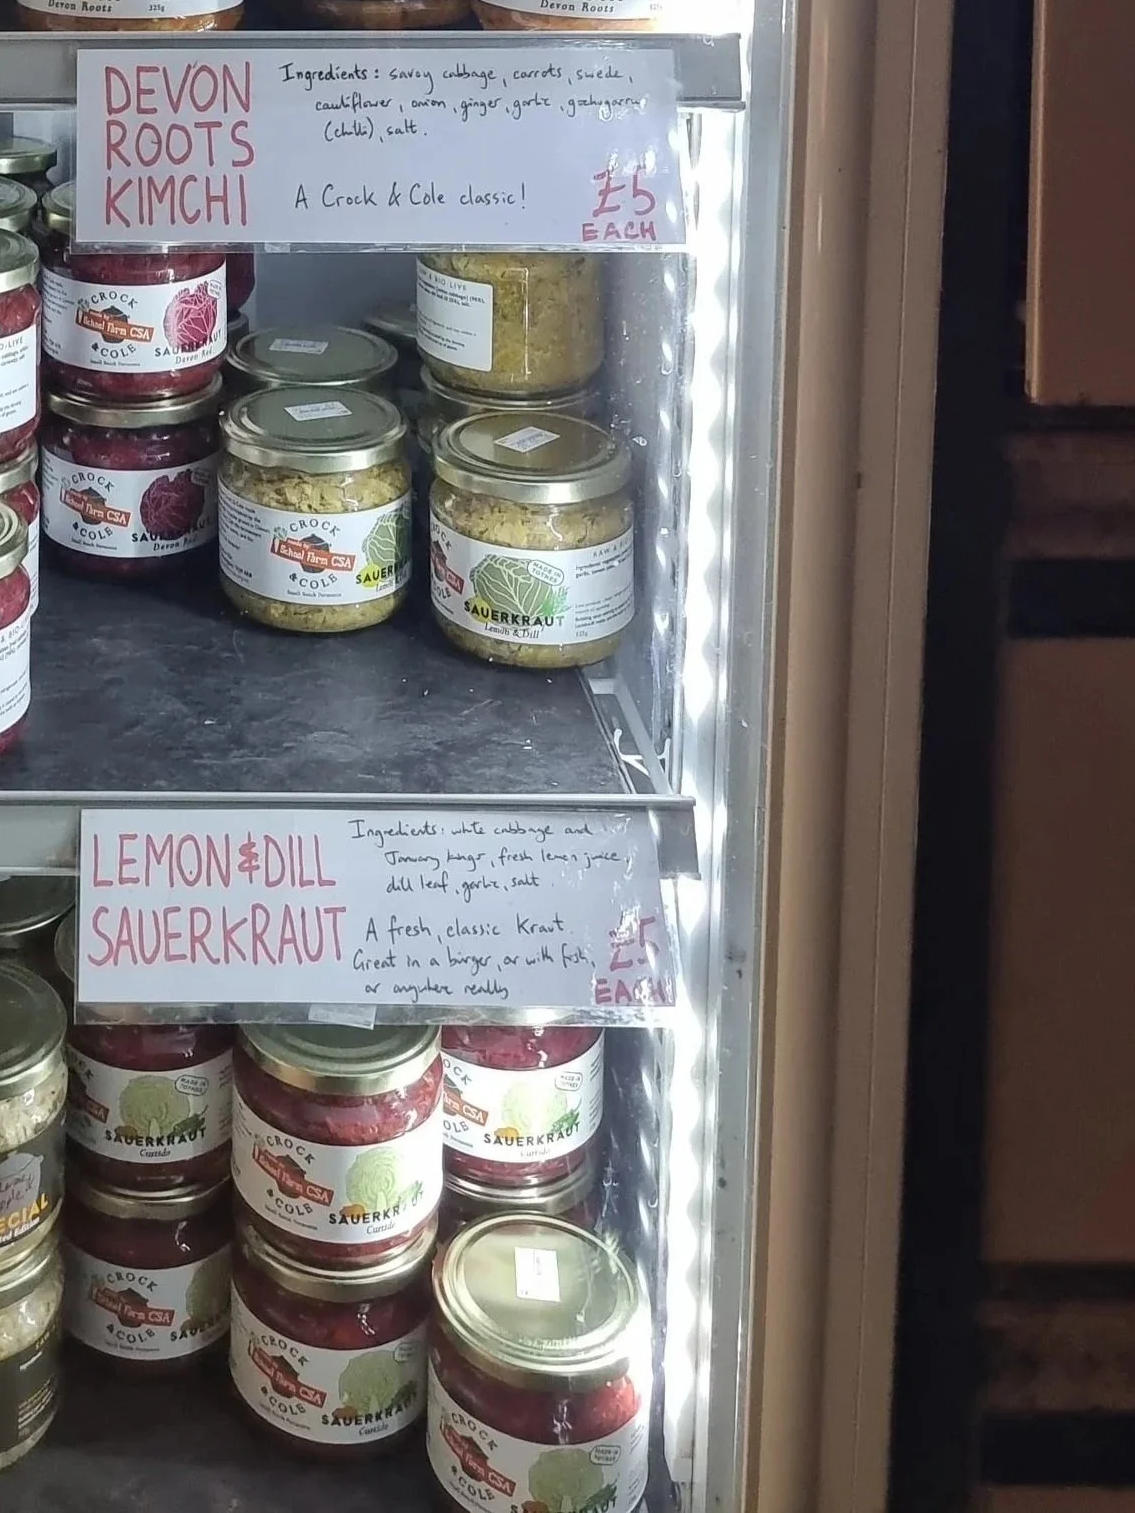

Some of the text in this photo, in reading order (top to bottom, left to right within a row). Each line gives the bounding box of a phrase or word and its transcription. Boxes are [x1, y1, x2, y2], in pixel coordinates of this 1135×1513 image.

[81, 1, 112, 13] Roots
[105, 61, 251, 115] DEVON
[389, 68, 434, 95] savoy
[106, 119, 254, 170] ROOTS
[106, 174, 247, 227] KIMCHI
[295, 181, 526, 209] A Crock & Cole classic!
[593, 165, 656, 217] £5
[582, 221, 657, 242] EACH
[83, 315, 150, 340] School Farm CSA
[289, 519, 341, 536] CROCK
[280, 546, 352, 569] School Farm CSA
[533, 562, 553, 573] MADE
[463, 601, 565, 627] SAUERKRAUT
[484, 623, 510, 636] Lemon
[451, 822, 485, 835] white
[494, 821, 554, 843] cabbage
[565, 824, 594, 835] and
[93, 833, 231, 888] LEMON
[264, 834, 336, 888] DILL
[498, 847, 533, 866] fresh
[541, 849, 578, 862] lemon
[386, 876, 414, 893] dill
[87, 903, 347, 966] SAUERKRAUT
[366, 917, 378, 942] A
[447, 917, 501, 938] classic
[353, 949, 397, 971] Great
[407, 955, 420, 968] in
[430, 957, 440, 967] a
[503, 956, 519, 966] or
[526, 946, 554, 964] with
[365, 983, 380, 994] or
[464, 980, 513, 1000] really
[463, 1104, 485, 1125] CSA
[105, 1127, 207, 1147] SAUERKRAUT
[483, 1122, 580, 1147] SAUERKRAUT
[266, 1134, 315, 1166] CROCK
[306, 1186, 330, 1204] CSA
[261, 1334, 309, 1367] CROCK
[451, 1412, 498, 1452] CROCK
[458, 1476, 496, 1501] COLE
